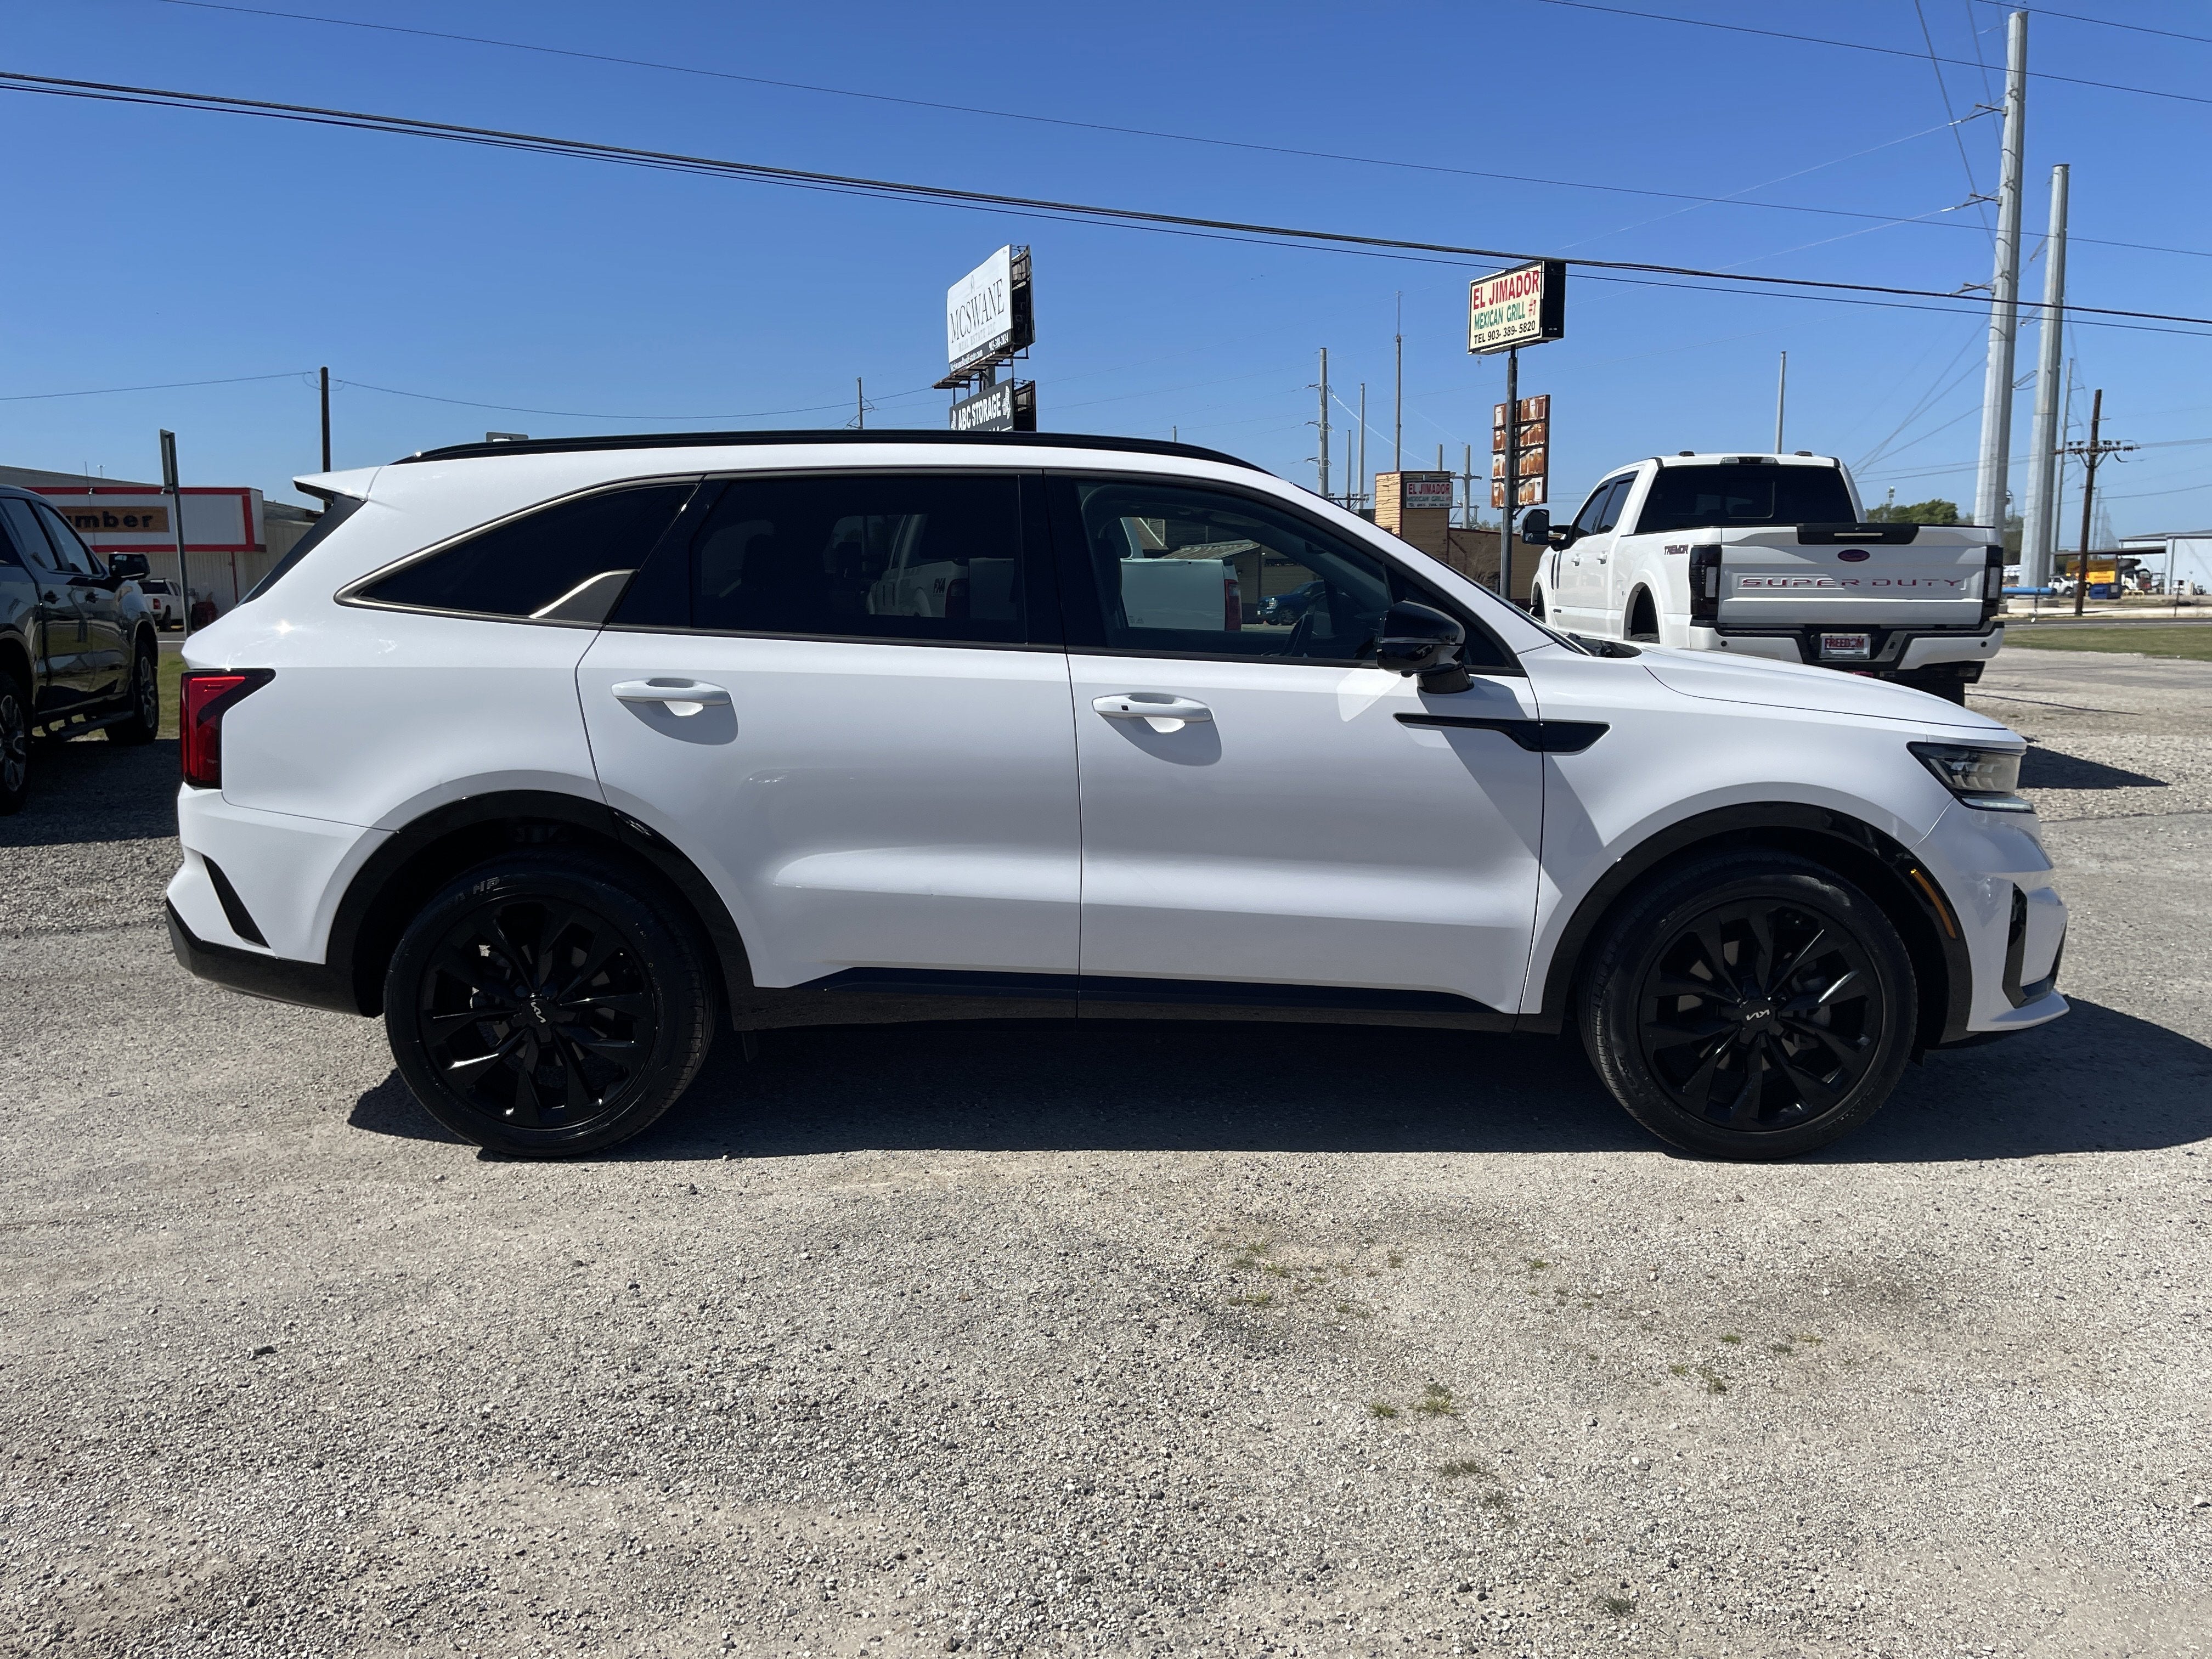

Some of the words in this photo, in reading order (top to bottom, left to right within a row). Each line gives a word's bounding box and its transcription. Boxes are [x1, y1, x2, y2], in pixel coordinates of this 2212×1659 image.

[1473, 286, 1486, 310] EL
[1489, 269, 1539, 306] JIMADOR
[1474, 307, 1503, 330] MEXICAN
[1507, 301, 1525, 322] GRILL
[970, 328, 986, 346] ESTATE
[1474, 334, 1486, 345] TEL
[958, 405, 972, 430] ABC
[972, 392, 1001, 426] STORAGE
[1408, 483, 1417, 494] EL
[1419, 483, 1450, 494] JIMADOR
[1741, 578, 1860, 587] SUPER
